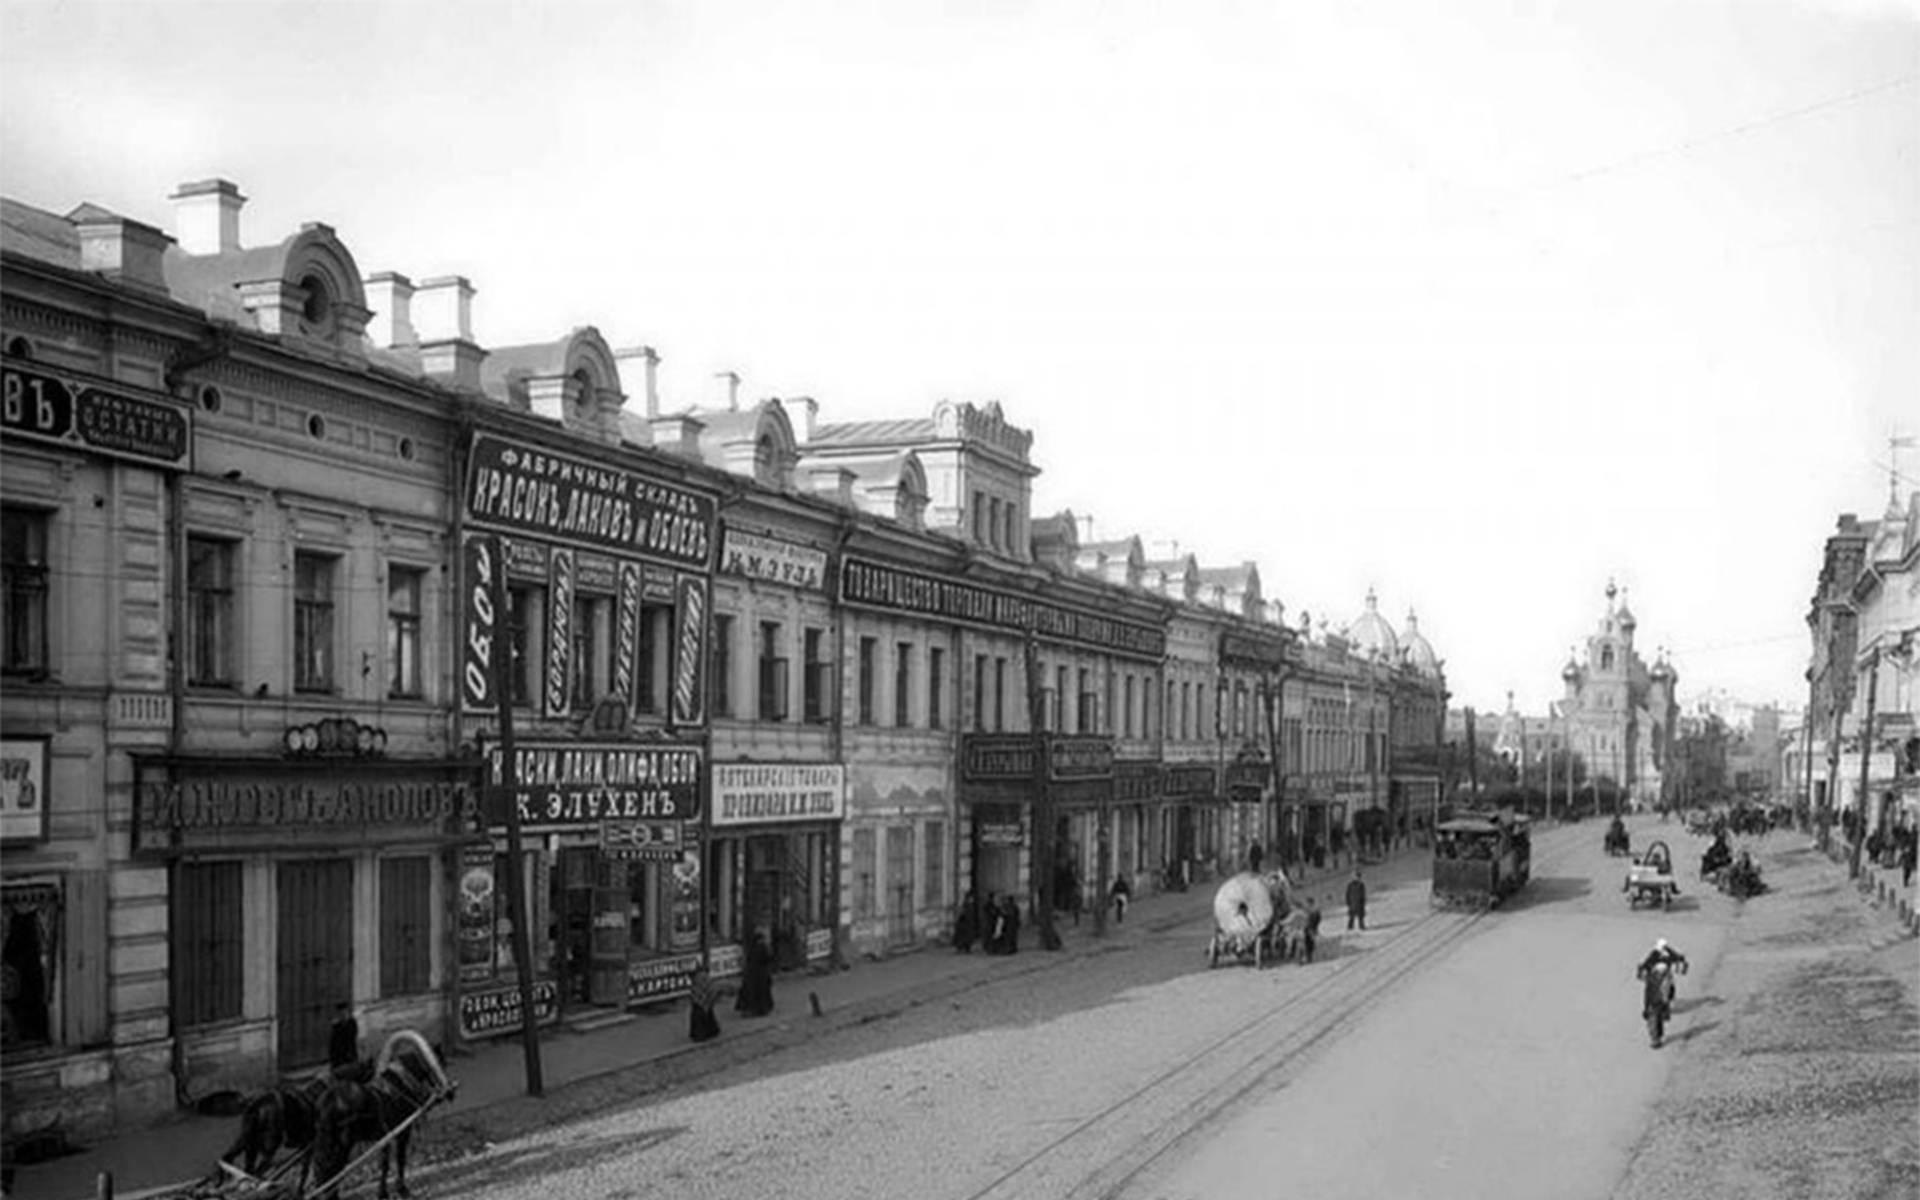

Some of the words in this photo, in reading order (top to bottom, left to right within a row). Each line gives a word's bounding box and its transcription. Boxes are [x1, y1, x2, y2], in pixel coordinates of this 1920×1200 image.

[4, 373, 54, 429] ВЪ
[84, 406, 178, 444] ОСТАТКИ
[501, 448, 628, 494] ФАБРИЧНЫЙ
[634, 482, 699, 514] СКЛАДЪ
[563, 488, 633, 542] ЛАКОВЪ
[649, 510, 708, 559] ОБОЕВЪ
[848, 563, 941, 612] ТОВАРИЩЕСТВО
[465, 543, 495, 701] ОБОИ
[548, 556, 570, 709] БОРДЮРЫ
[491, 750, 561, 791] КАСКИ,
[661, 751, 698, 785] ОБОИ
